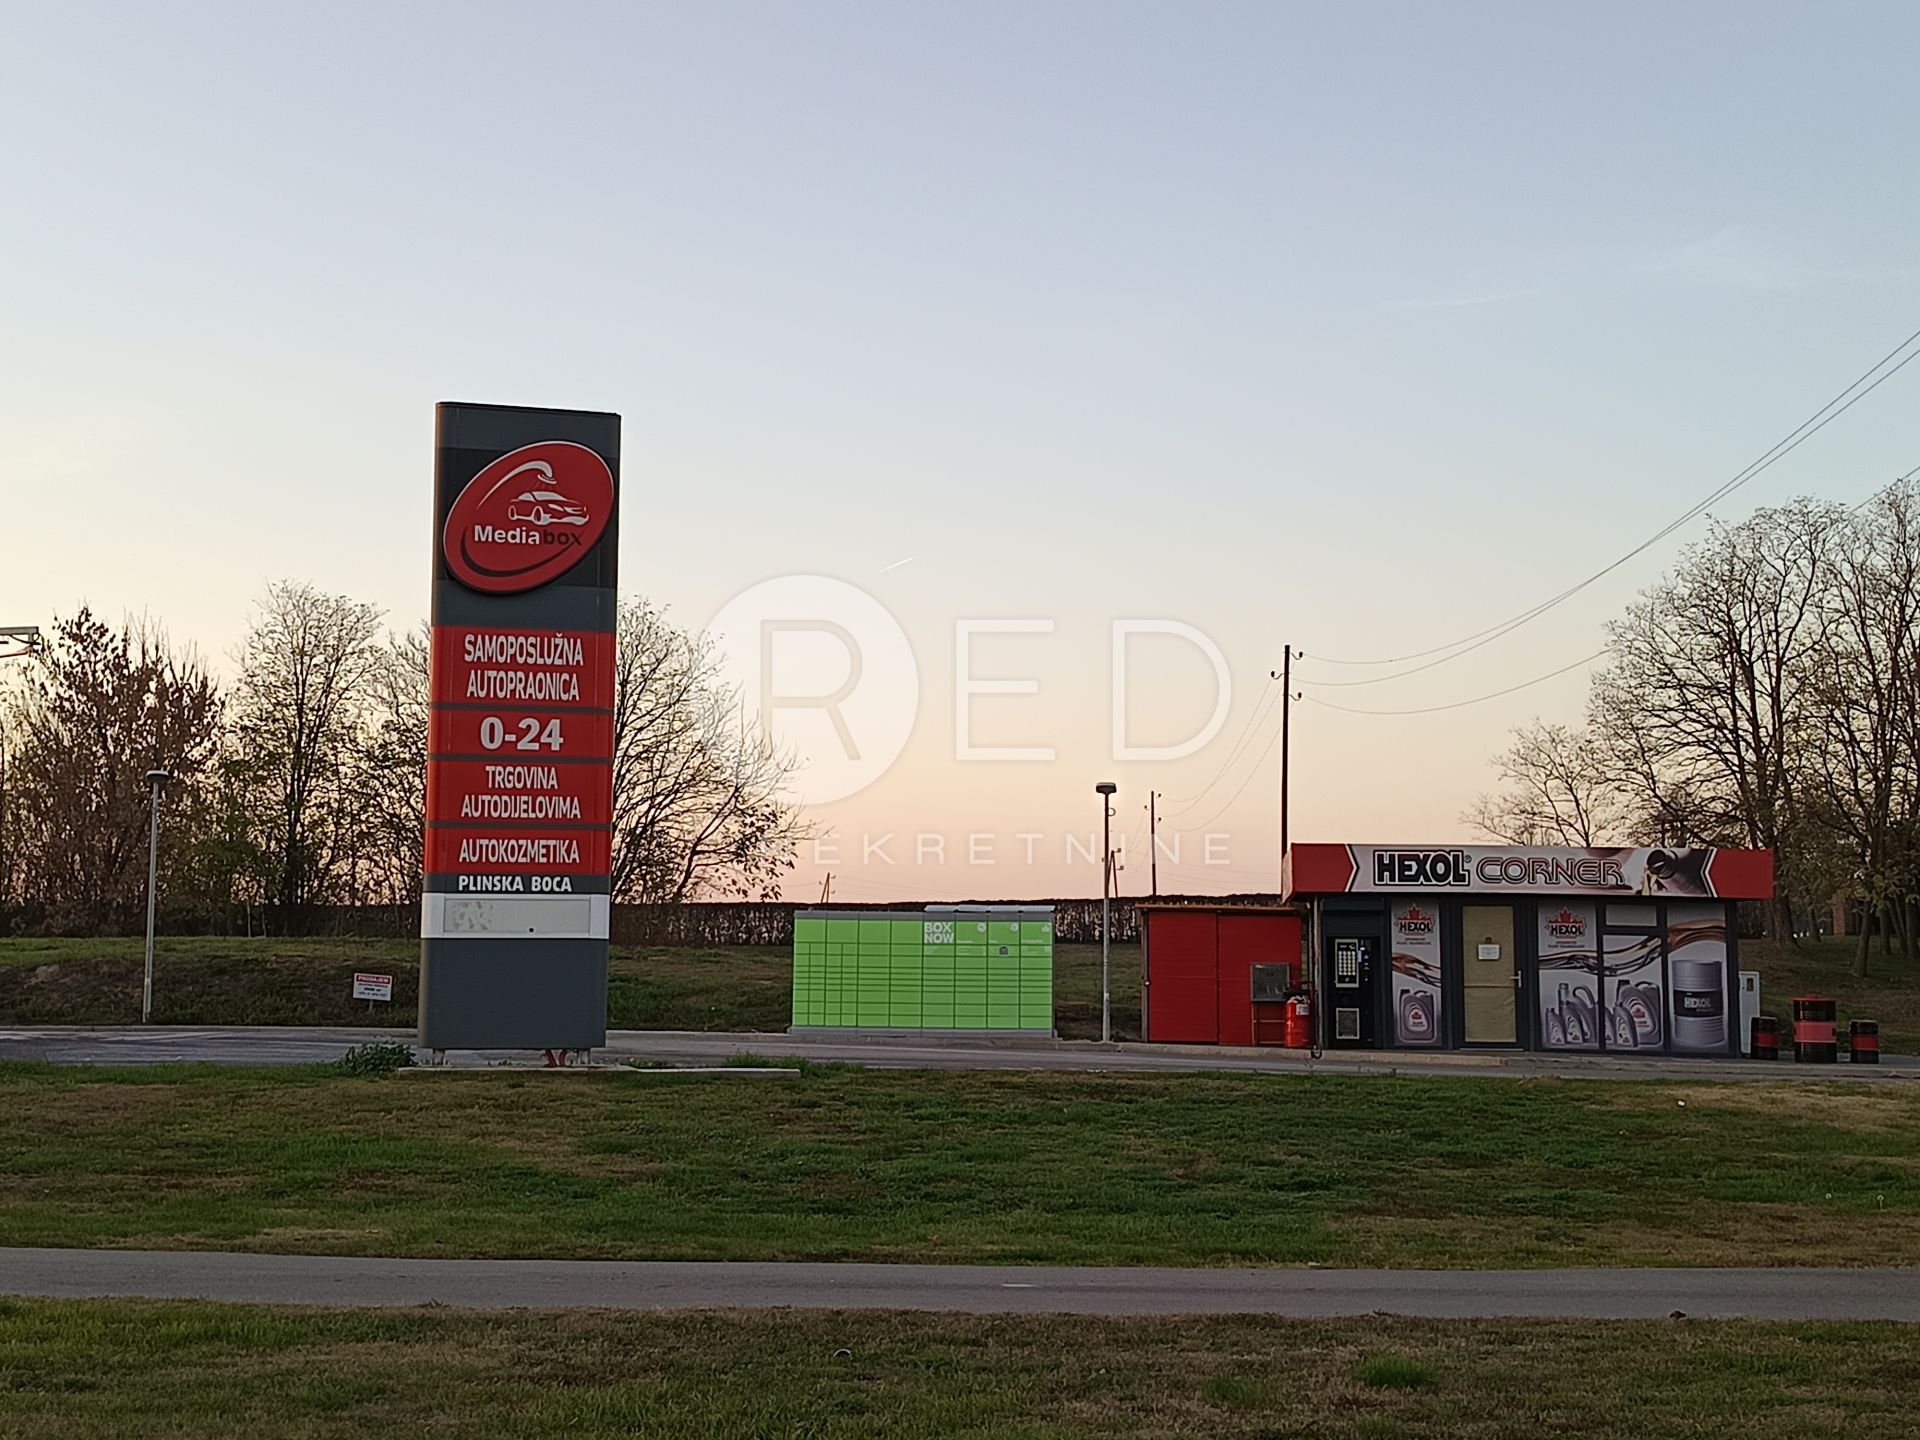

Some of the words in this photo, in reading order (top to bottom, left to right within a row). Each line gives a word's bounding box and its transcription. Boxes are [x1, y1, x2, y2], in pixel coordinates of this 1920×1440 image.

[474, 524, 583, 546] Mediabox
[464, 633, 584, 666] SAMOPOSLUŽNA
[467, 669, 580, 701] AUTOPRAONICA
[480, 716, 564, 751] 0-24
[485, 765, 559, 790] TRGOVINA
[461, 795, 582, 819] AUTODIJELOVIMA
[459, 838, 580, 864] AUTOKOZMETIKA
[1476, 856, 1624, 886] CORNER
[458, 875, 524, 892] PLINSKA
[531, 876, 573, 892] BOCA
[924, 922, 952, 933] BOX
[924, 933, 954, 944] NOW
[1400, 921, 1432, 932] HEXOL
[1550, 923, 1584, 935] HEXOL
